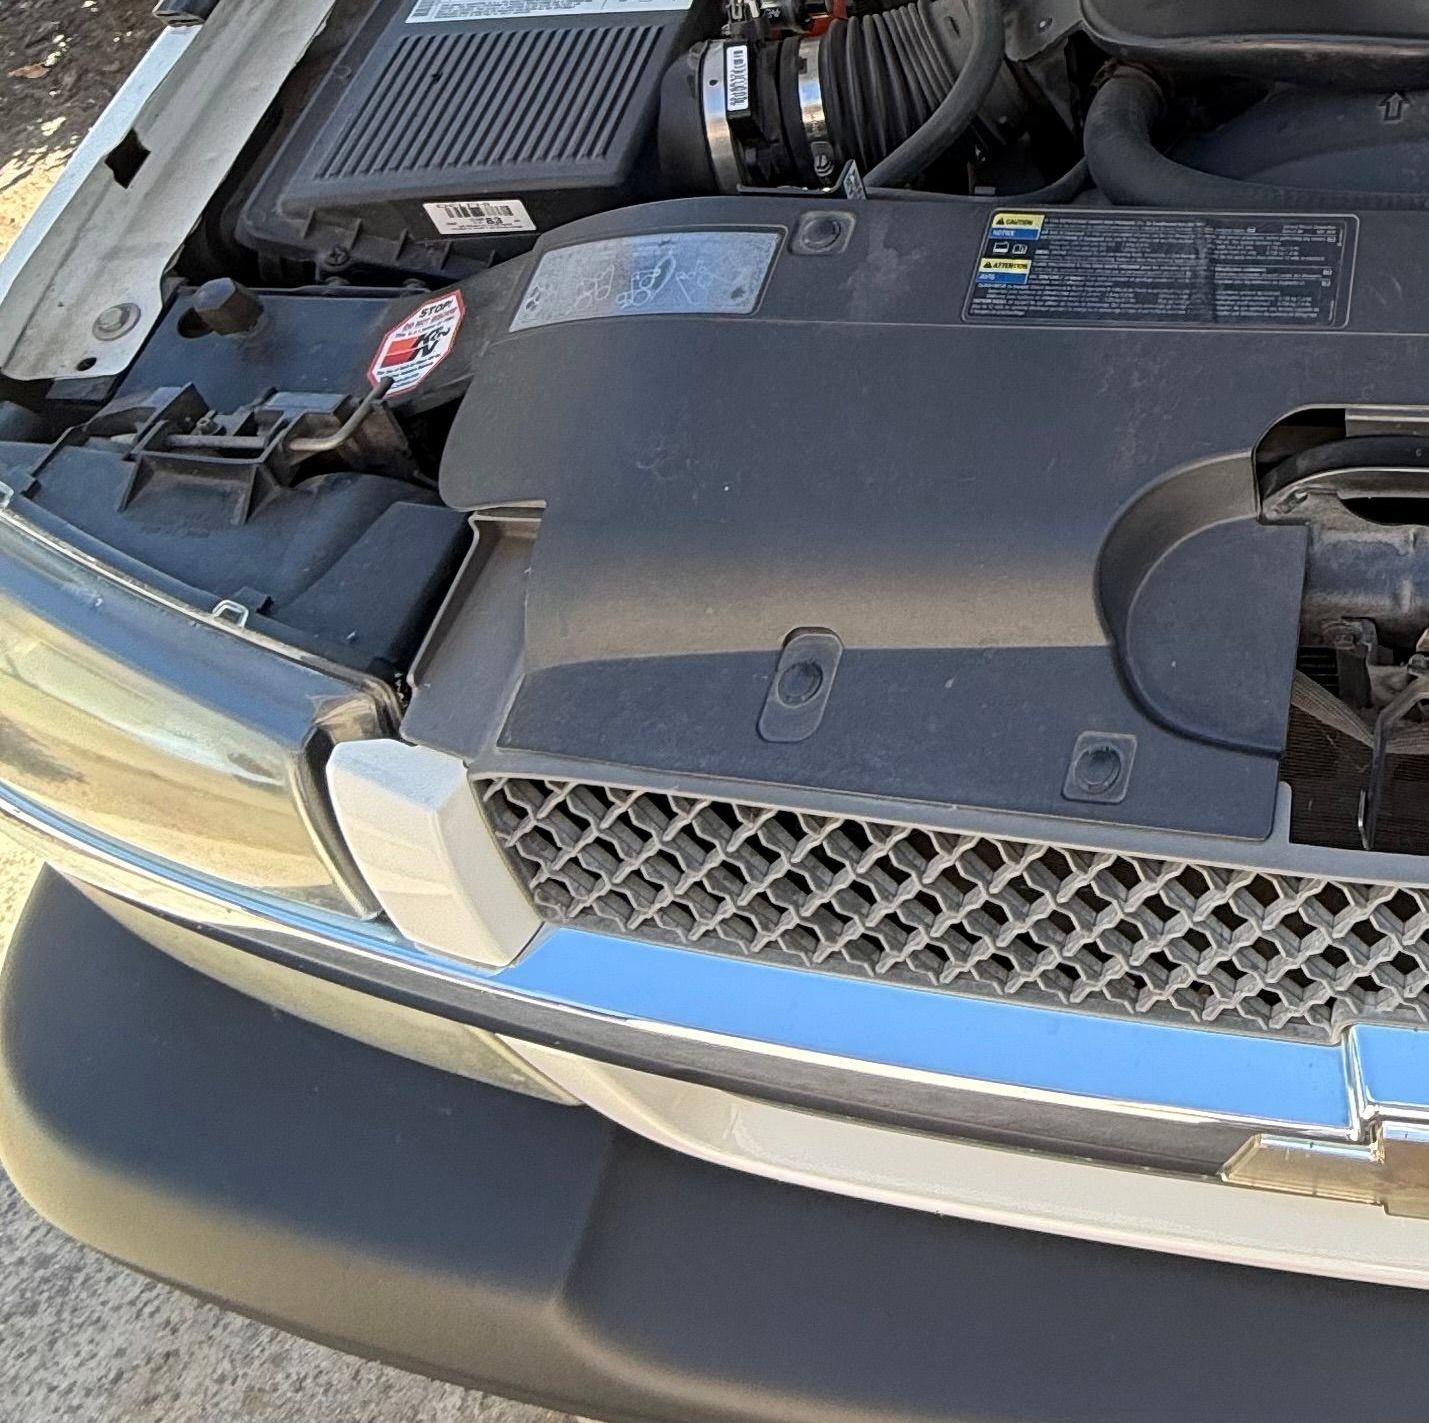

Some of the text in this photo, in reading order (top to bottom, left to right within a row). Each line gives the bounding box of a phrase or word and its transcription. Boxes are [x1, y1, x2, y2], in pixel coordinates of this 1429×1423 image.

[1005, 218, 1034, 226] CAUTION
[992, 229, 1016, 237] NOTICE
[993, 261, 1028, 270] ATTENTION
